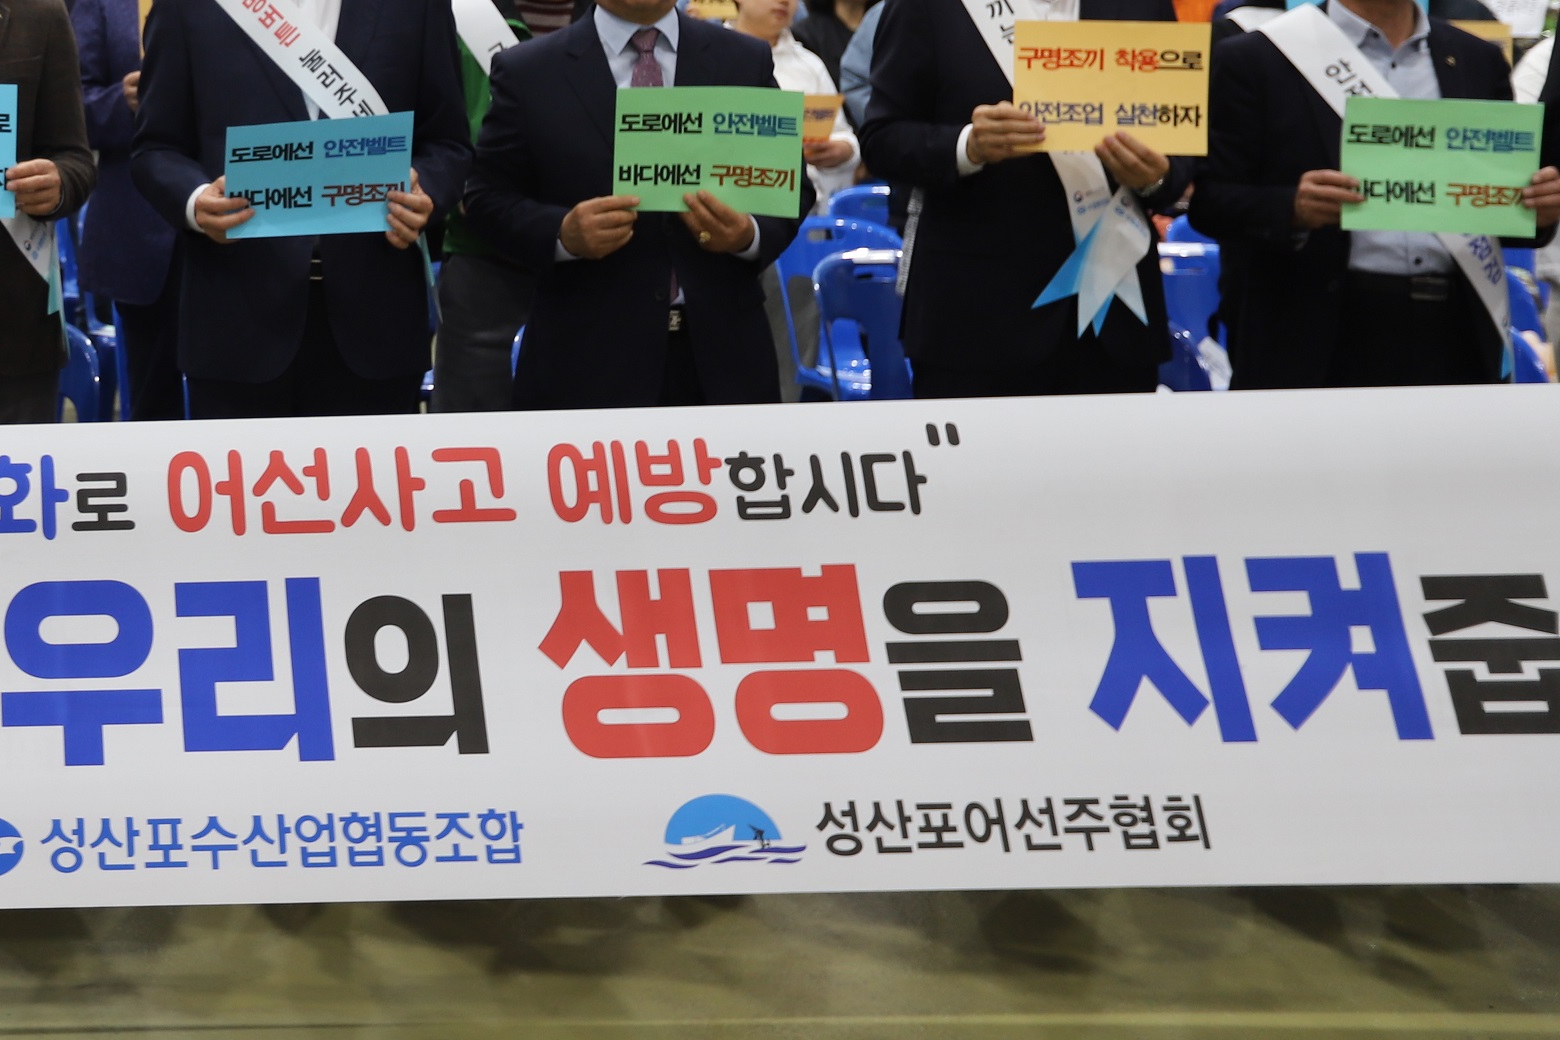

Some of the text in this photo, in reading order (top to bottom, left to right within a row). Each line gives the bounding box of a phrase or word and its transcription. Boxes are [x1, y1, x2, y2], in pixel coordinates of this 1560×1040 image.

[1017, 47, 1203, 72] 구명조끼 착용으로
[619, 112, 703, 135] 도로에선
[713, 113, 798, 137] 안전벨트
[1115, 104, 1201, 128] 실천하자
[229, 136, 407, 163] 도로에선 안전벨트
[1347, 124, 1535, 153] 도로에선 안전벨트
[619, 164, 795, 192] 바다에선 구명조끼
[167, 445, 517, 537] 어선사고
[547, 422, 960, 527] 예방합시다"
[1, 576, 490, 766] 우리의
[538, 563, 1035, 759] 생명을
[815, 795, 1212, 857] 성산포어선주협회
[41, 809, 524, 874] 성산포수산업협동조합
